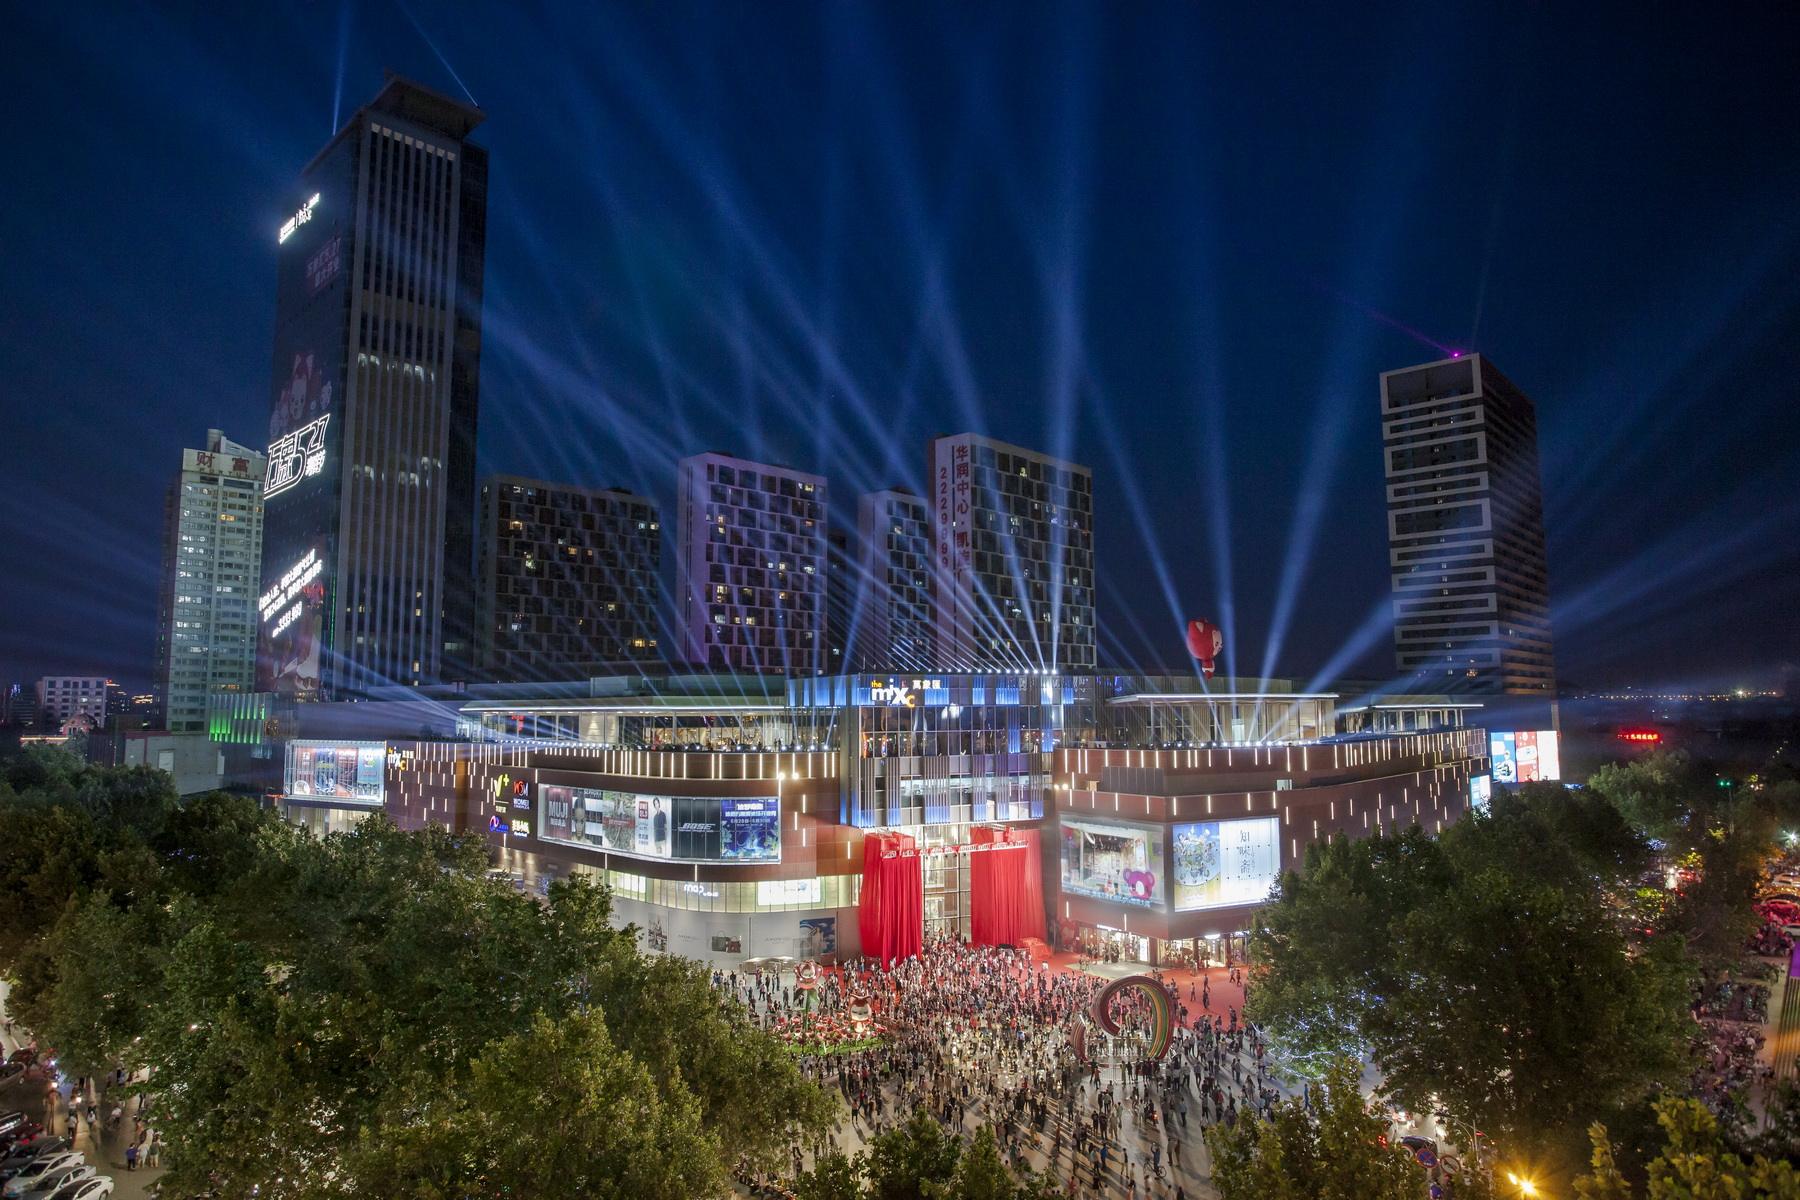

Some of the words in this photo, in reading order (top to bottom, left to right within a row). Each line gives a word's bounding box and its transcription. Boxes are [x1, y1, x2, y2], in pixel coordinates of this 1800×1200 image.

[196, 450, 250, 473] 财富
[548, 800, 569, 818] MUJI
[678, 822, 716, 833] BOSE
